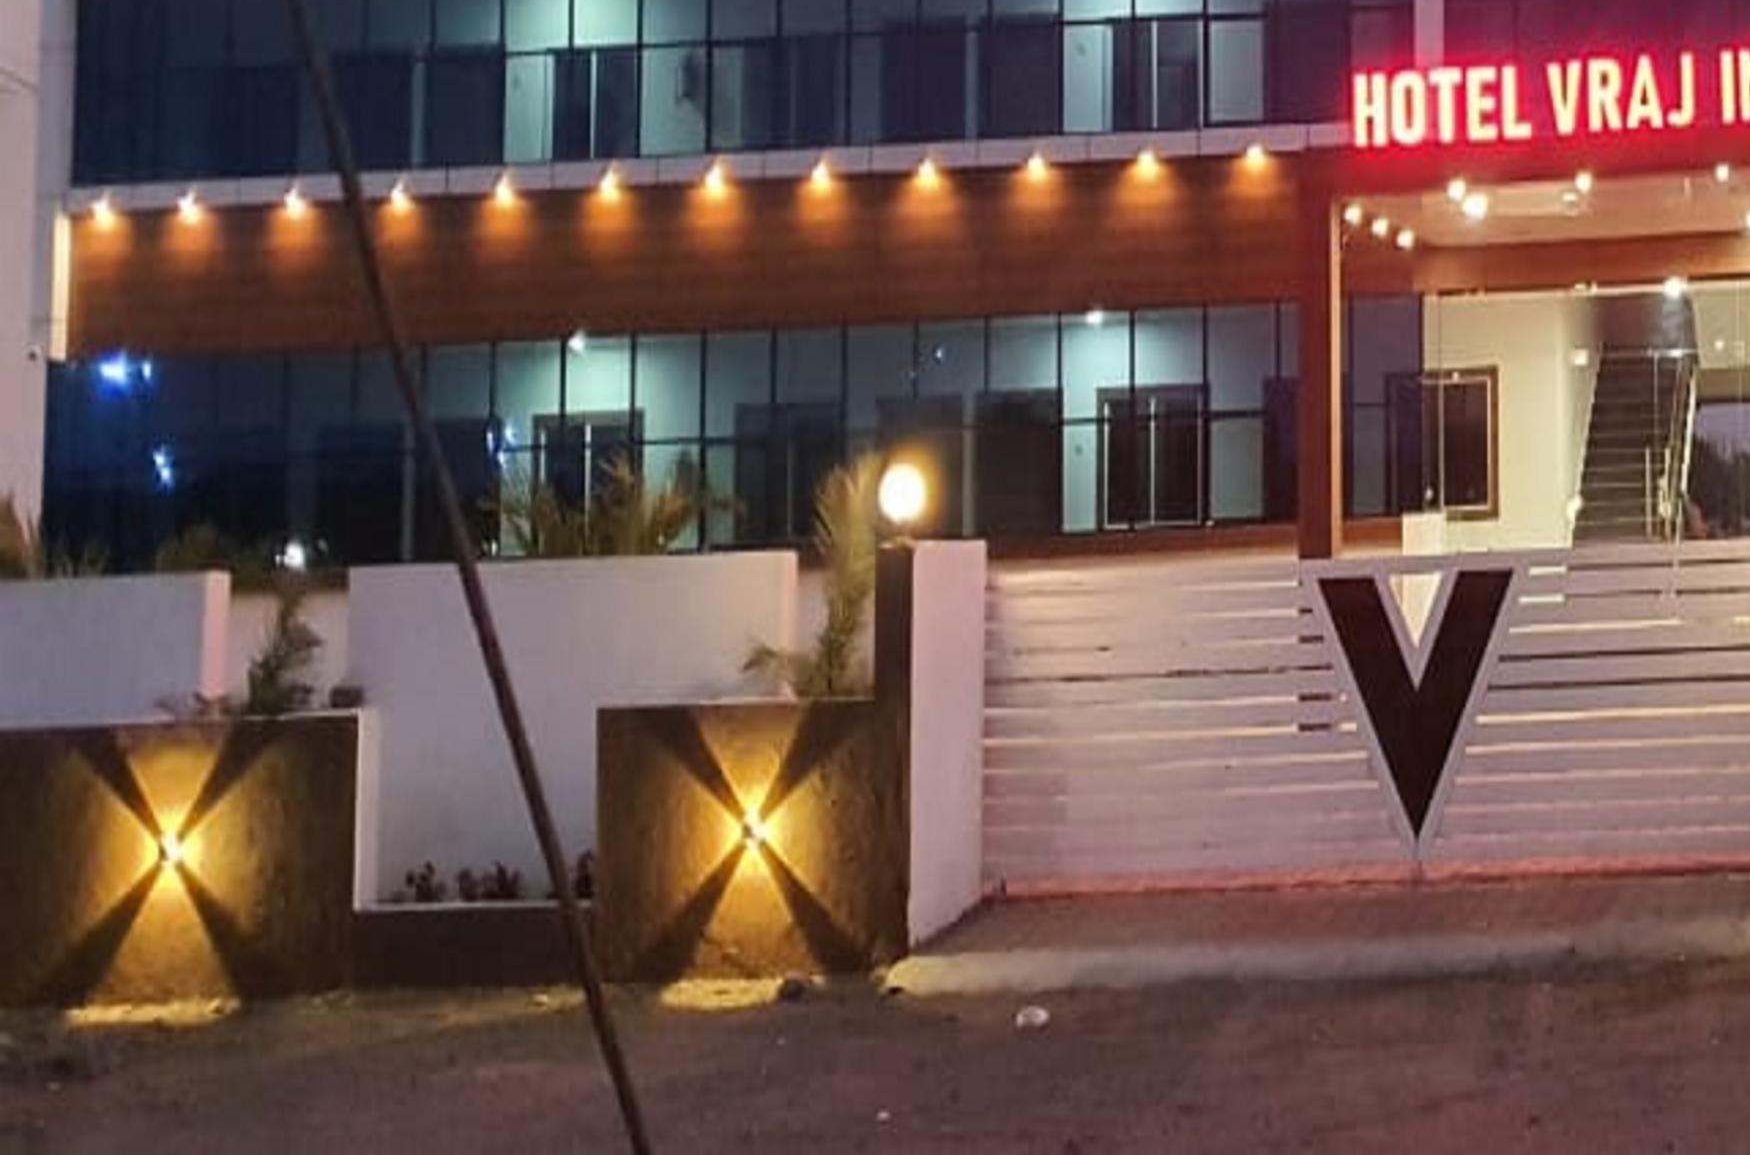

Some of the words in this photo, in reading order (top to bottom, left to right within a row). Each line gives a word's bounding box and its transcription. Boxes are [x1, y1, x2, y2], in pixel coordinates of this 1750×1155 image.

[1353, 65, 1533, 148] HOTEL
[1546, 52, 1696, 136] VRAJ
[1318, 569, 1513, 842] V
